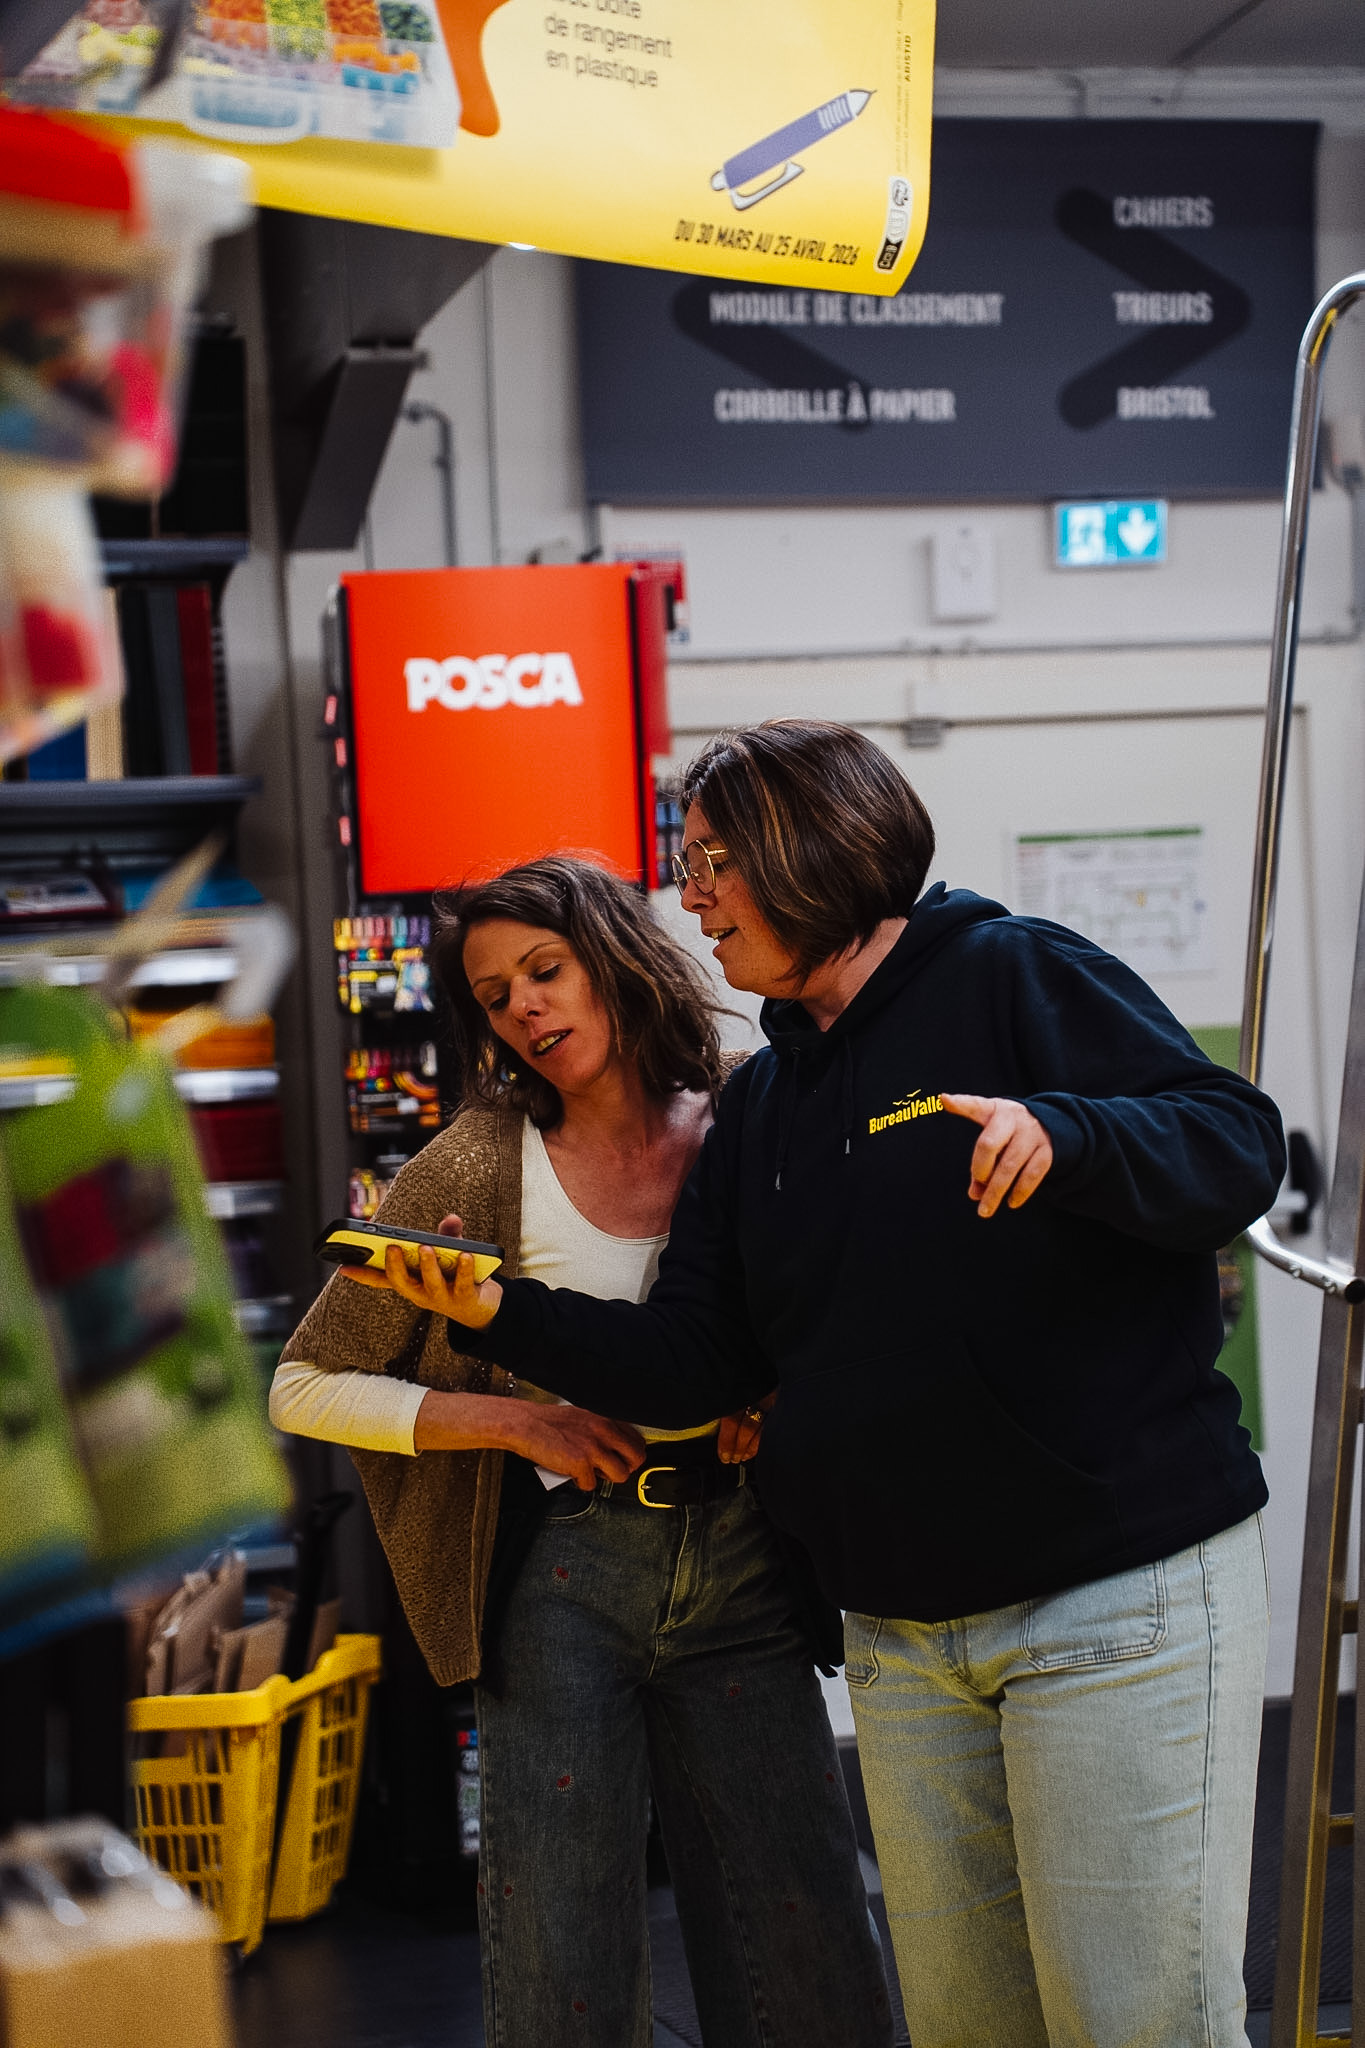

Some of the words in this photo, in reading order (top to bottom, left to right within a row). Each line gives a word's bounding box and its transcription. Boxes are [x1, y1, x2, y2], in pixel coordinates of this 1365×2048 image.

[545, 12, 568, 37] de
[575, 23, 672, 58] rangement
[546, 50, 569, 71] en
[575, 54, 658, 88] plastique
[1113, 196, 1214, 228] CAHIERS
[675, 219, 695, 241] DU
[696, 223, 714, 244] 30
[715, 225, 753, 250] MARS
[755, 231, 775, 253] AU
[774, 235, 792, 256] 25
[792, 238, 826, 261] AVRIL
[828, 242, 860, 266] 2026
[709, 292, 809, 325] MODULE
[813, 292, 846, 325] DE
[850, 292, 1003, 325] CLASSEMENT
[1113, 291, 1214, 324] TRIEURS
[714, 388, 844, 422] CORBEILLE
[869, 388, 956, 422] PAPIER
[404, 652, 583, 713] POSCA
[869, 1094, 944, 1134] BureauVallé
